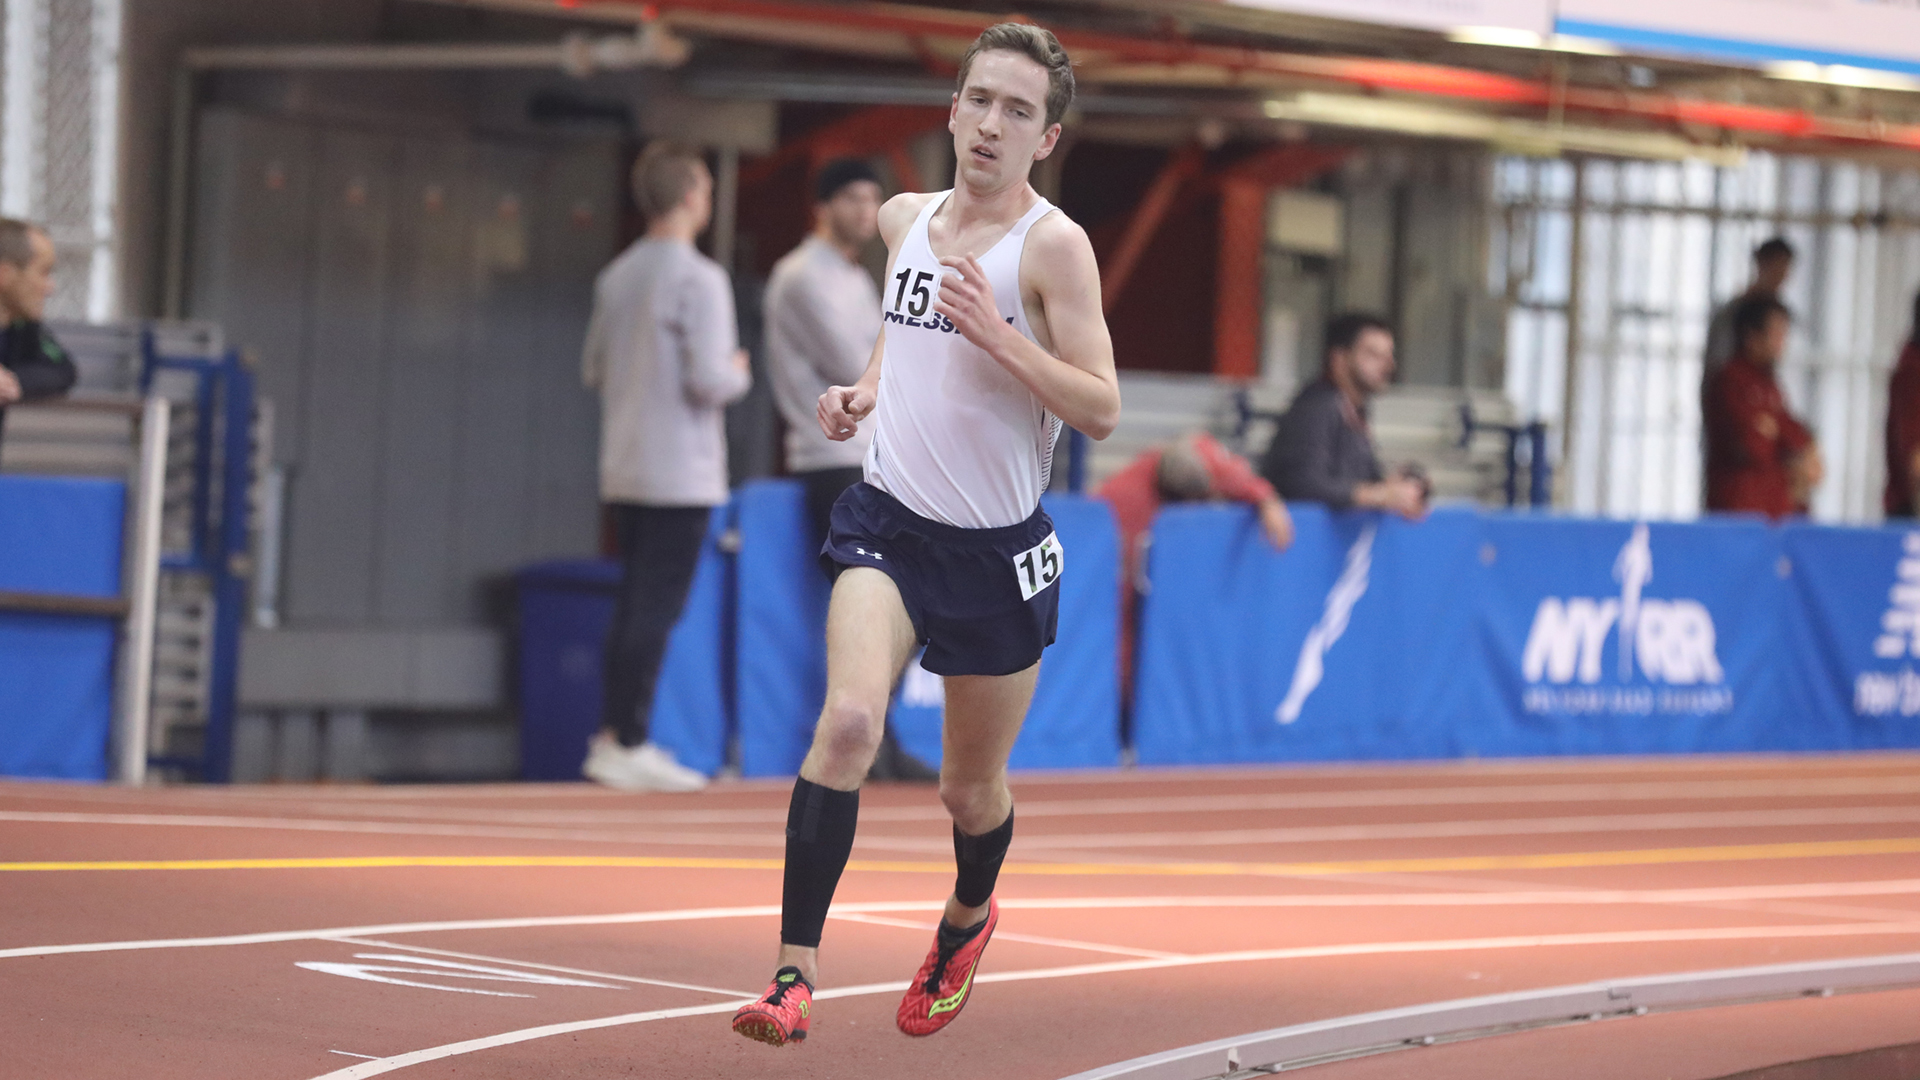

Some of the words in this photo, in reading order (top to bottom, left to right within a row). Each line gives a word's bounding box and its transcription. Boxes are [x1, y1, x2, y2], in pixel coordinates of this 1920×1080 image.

[895, 268, 934, 317] 15
[884, 311, 1014, 334] MESS
[1020, 538, 1058, 593] 15
